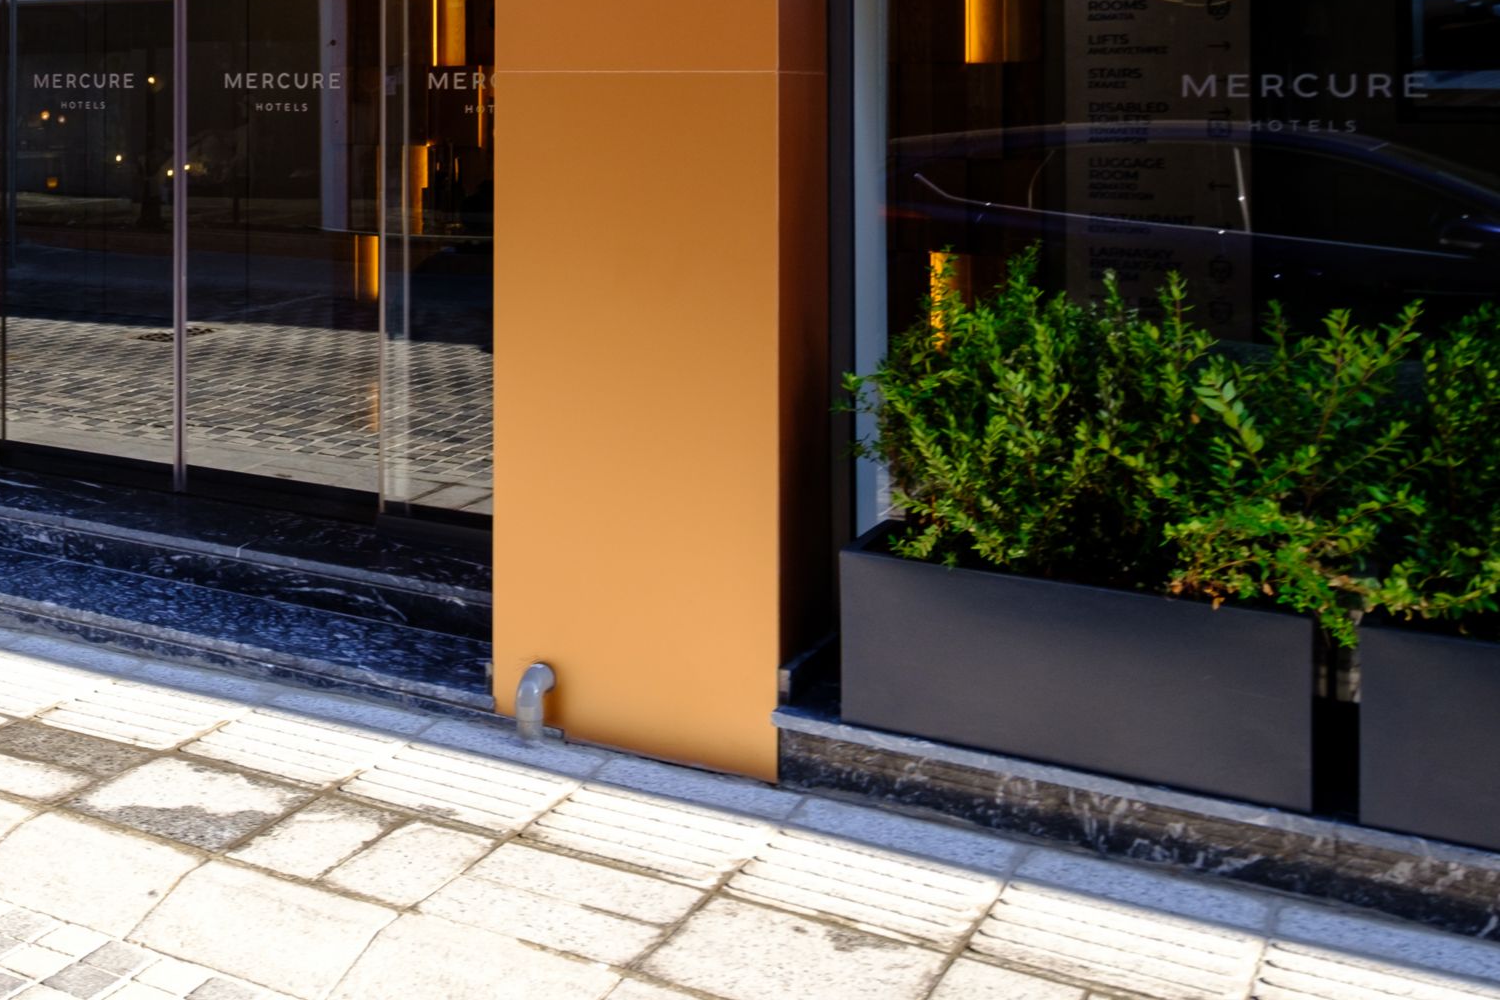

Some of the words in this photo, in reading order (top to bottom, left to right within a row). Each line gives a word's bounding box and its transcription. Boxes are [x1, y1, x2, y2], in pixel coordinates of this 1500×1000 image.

[1088, 0, 1148, 11] ROOMS
[1088, 33, 1130, 45] LIFTS
[1088, 67, 1144, 79] STAIRS
[33, 73, 134, 89] MERCURE
[224, 73, 341, 89] MERCURE
[1181, 73, 1428, 98] MERCURE
[60, 101, 106, 110] HOTELS
[255, 103, 308, 112] HOTELS
[1088, 102, 1169, 113] DISABLED
[1250, 119, 1357, 133] HOTELS
[1089, 157, 1165, 169] LUGGAGE
[1089, 170, 1139, 181] ROOM
